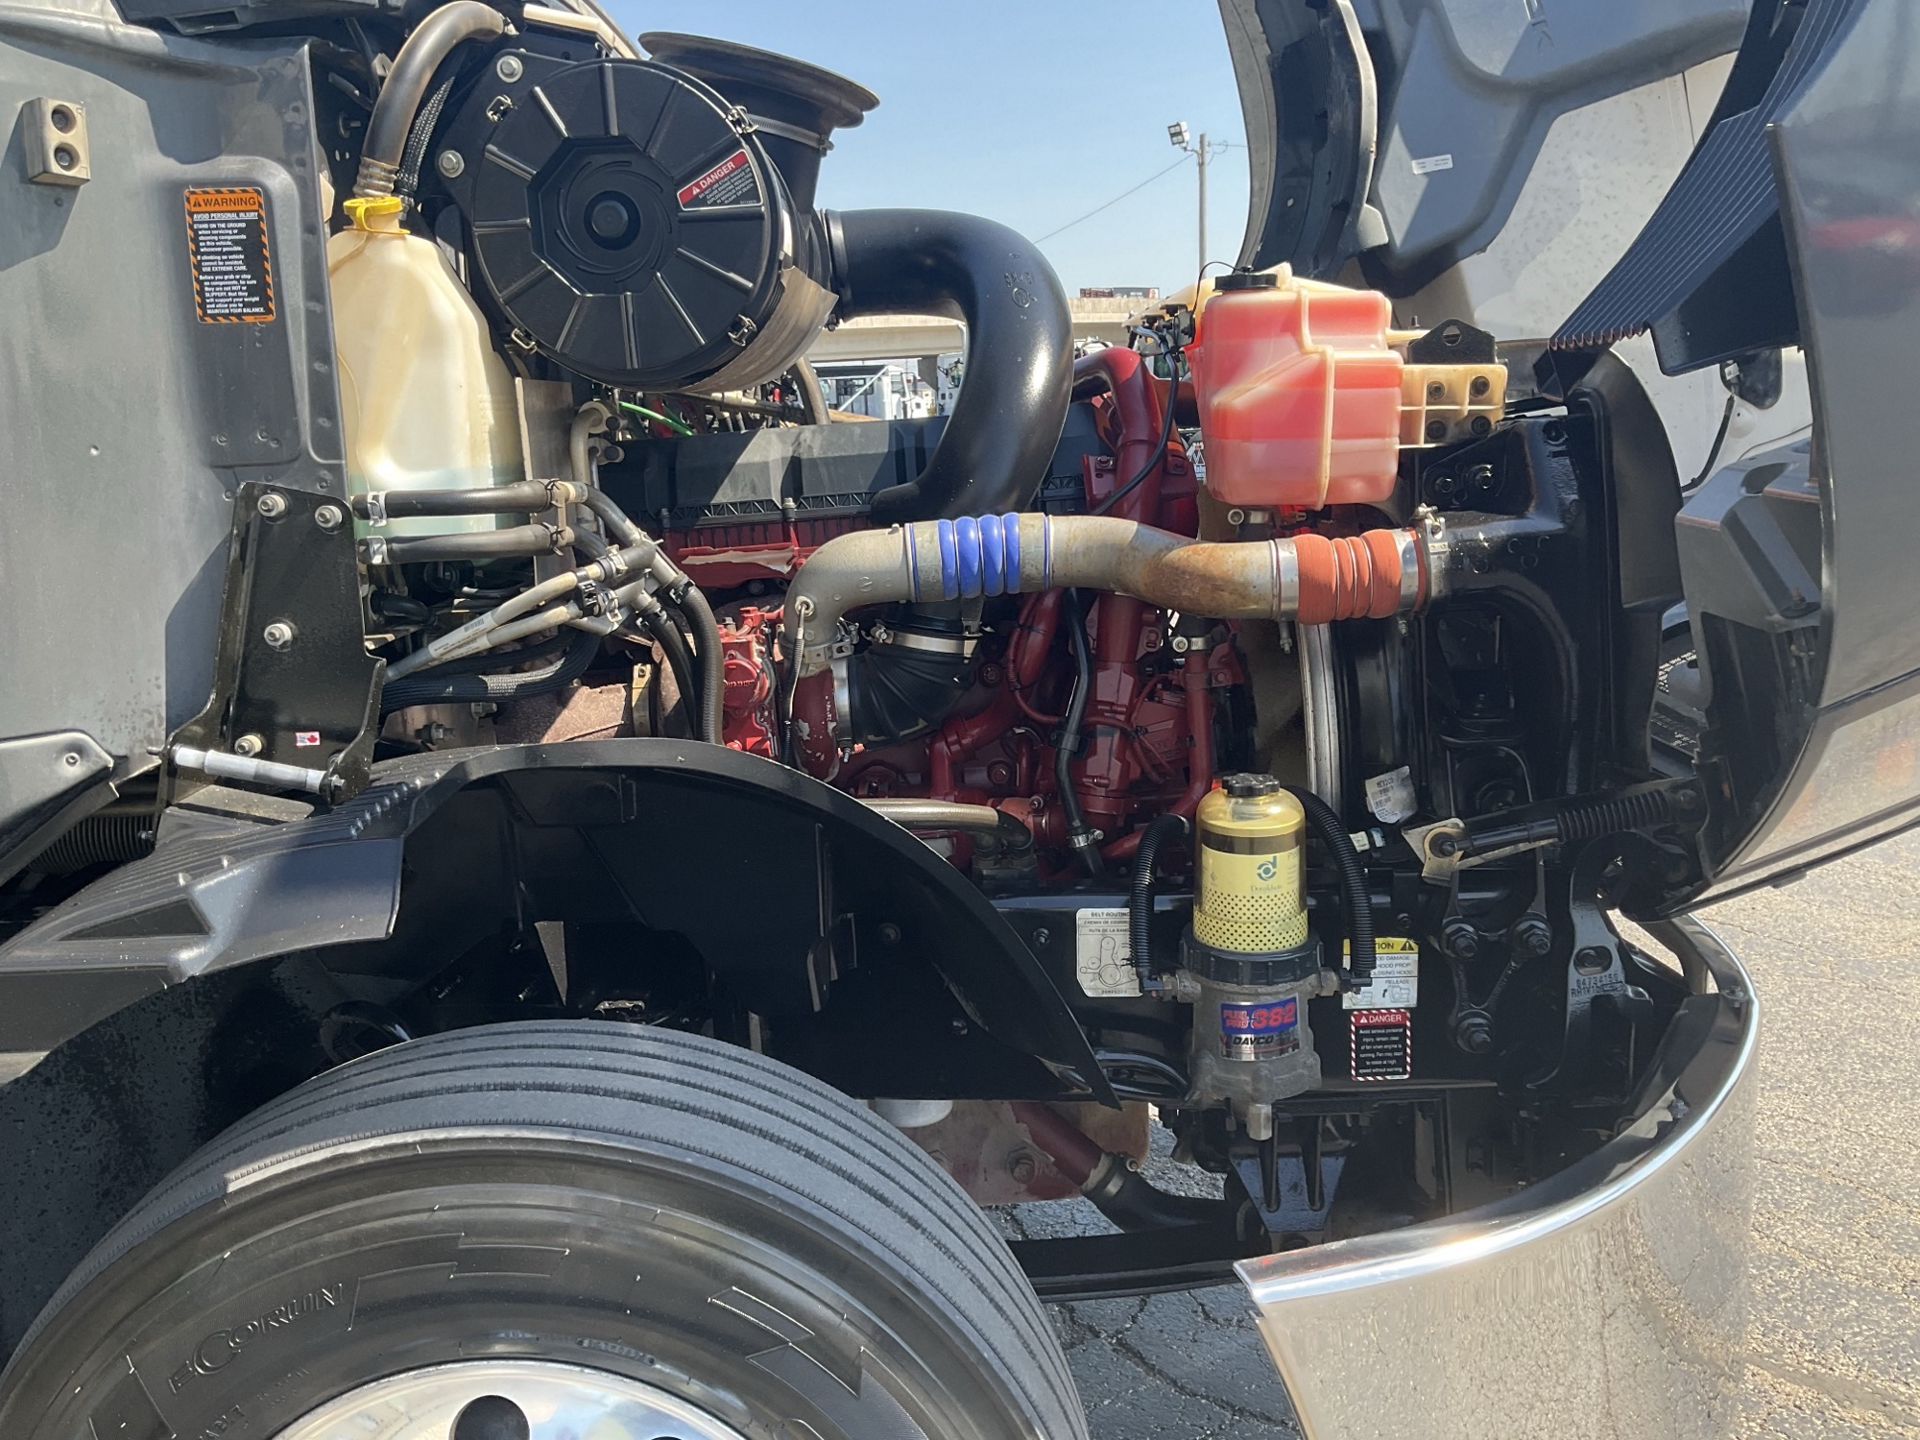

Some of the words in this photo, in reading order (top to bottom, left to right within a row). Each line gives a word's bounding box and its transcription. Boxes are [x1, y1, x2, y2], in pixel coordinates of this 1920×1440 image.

[700, 161, 736, 189] DANGER
[202, 197, 258, 207] WARNING
[1250, 1001, 1297, 1030] 382
[1369, 1014, 1402, 1023] DANGER
[1232, 1034, 1274, 1045] DAVCO
